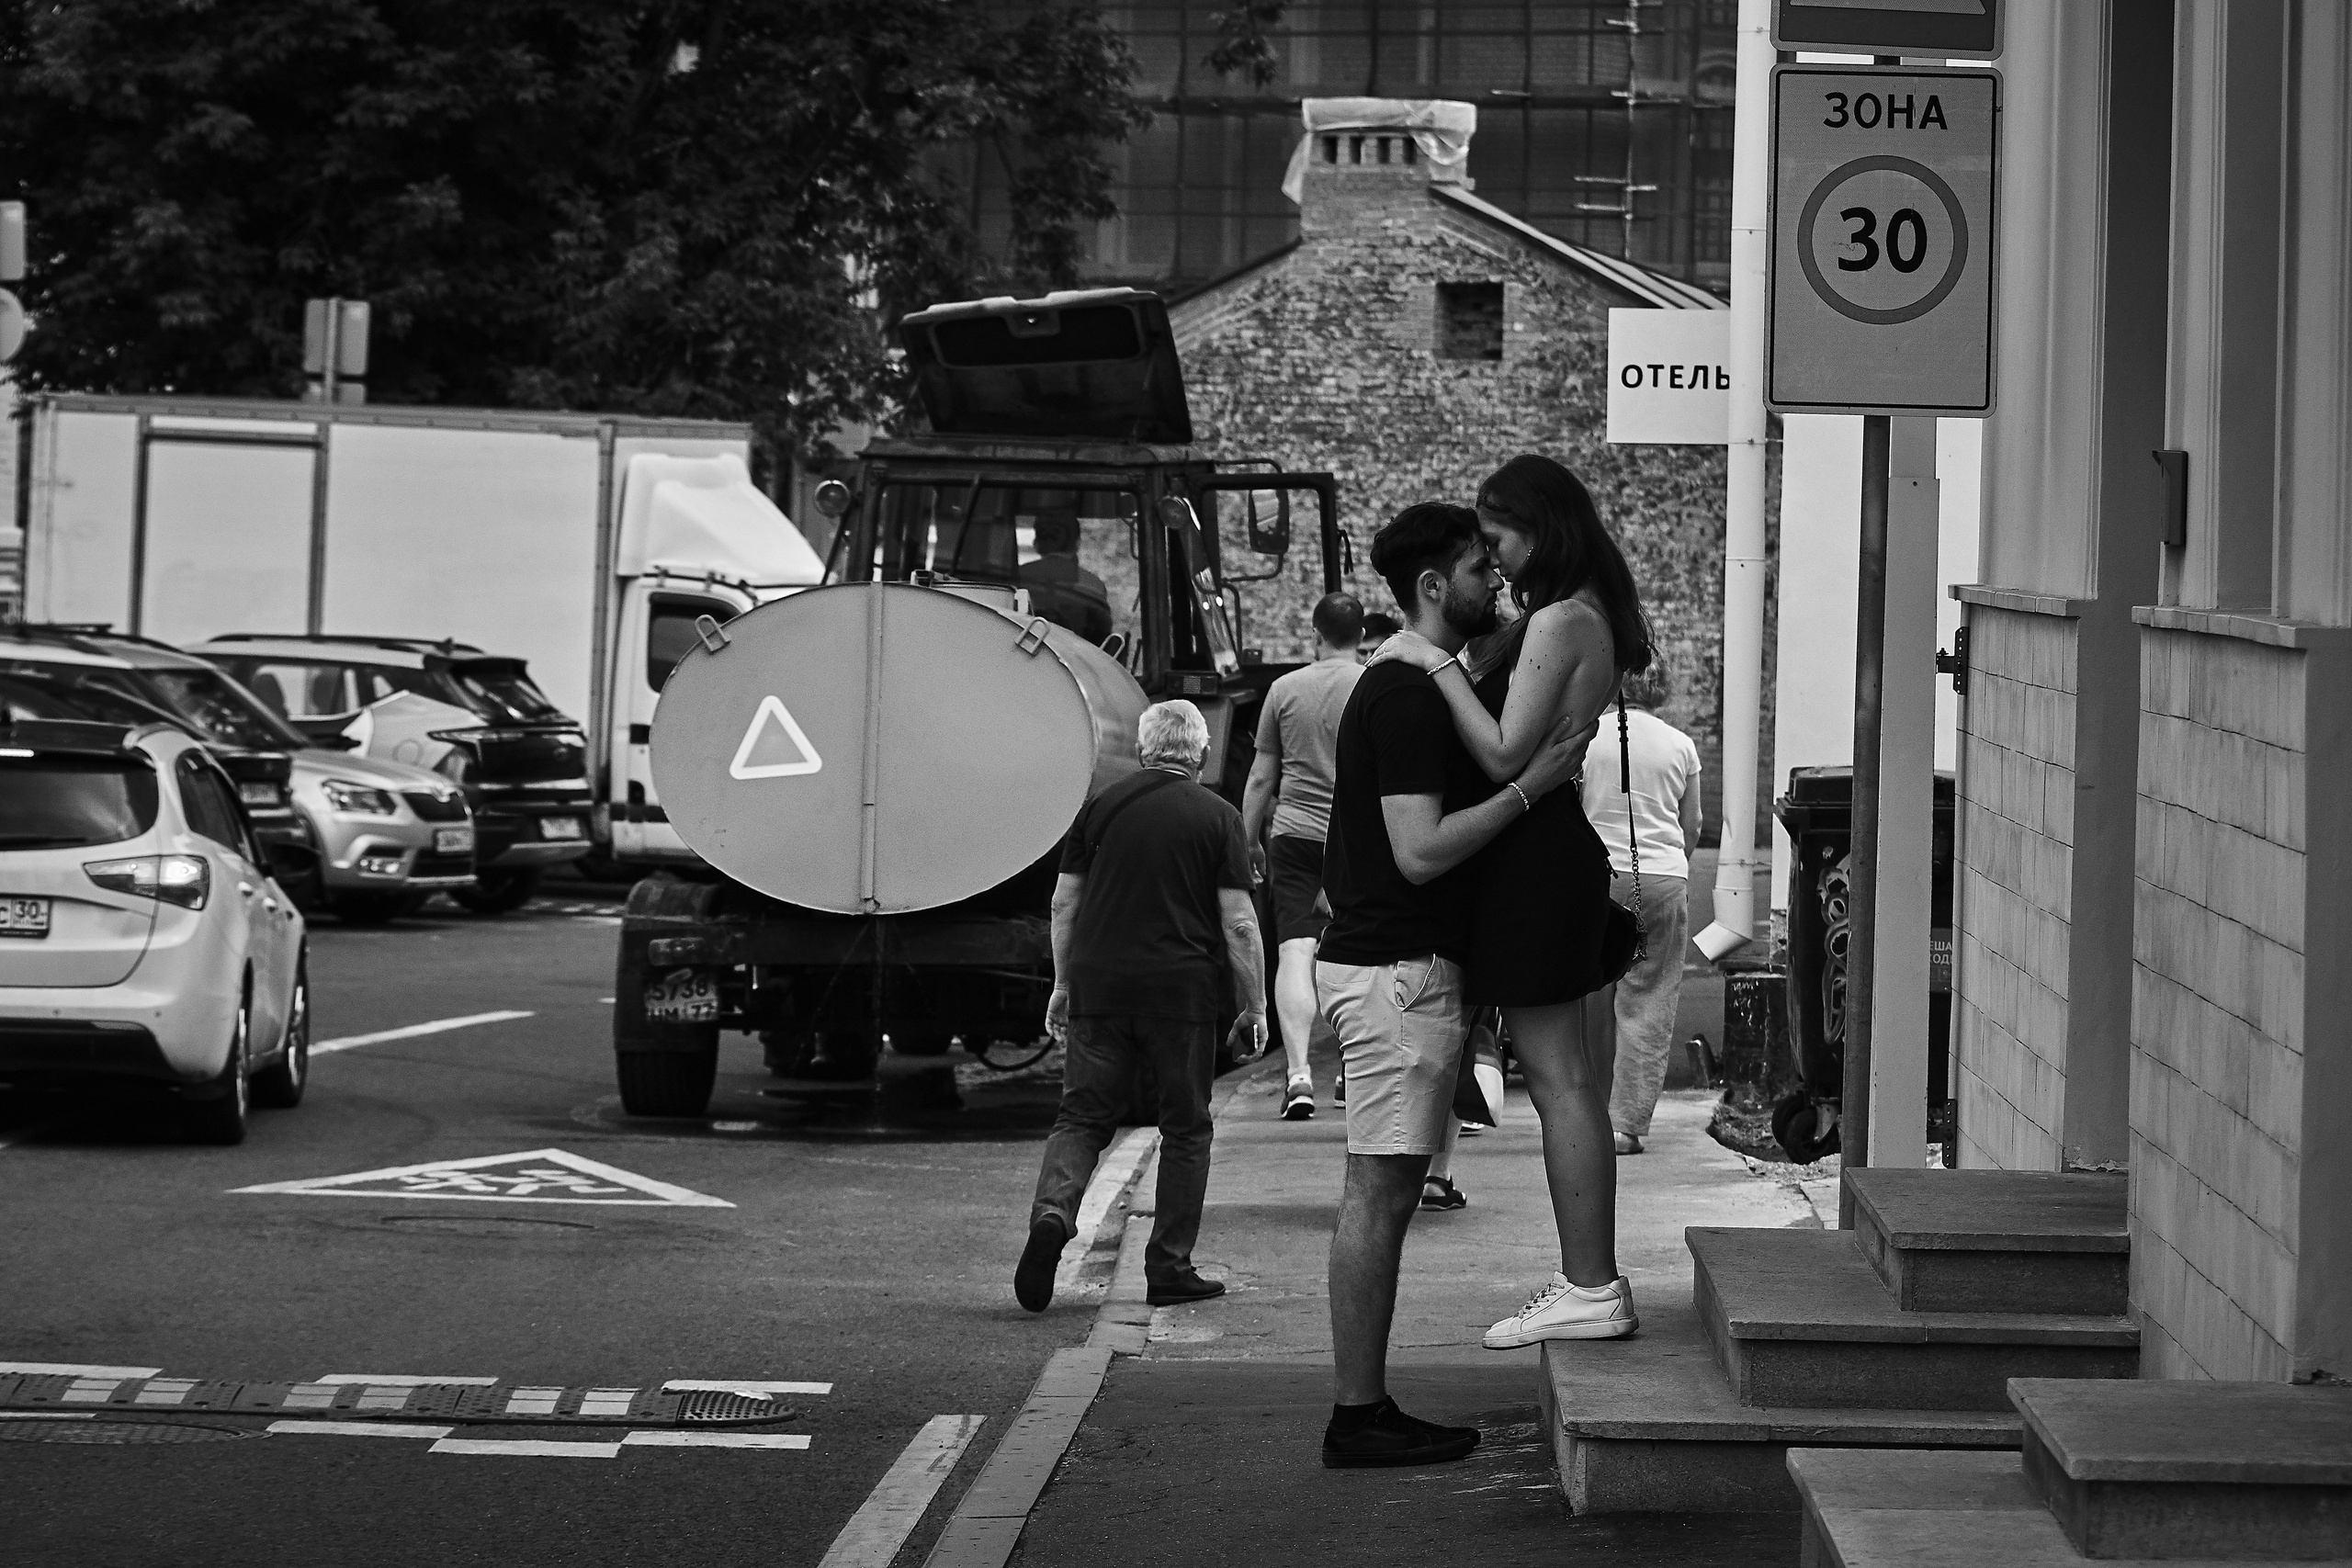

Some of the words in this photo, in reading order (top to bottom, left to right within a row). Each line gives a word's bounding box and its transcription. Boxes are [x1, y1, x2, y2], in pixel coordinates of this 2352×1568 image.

[1823, 92, 1948, 130] ЗОНА
[1838, 206, 1928, 274] 30
[1621, 364, 1730, 390] ОТЕЛЬ
